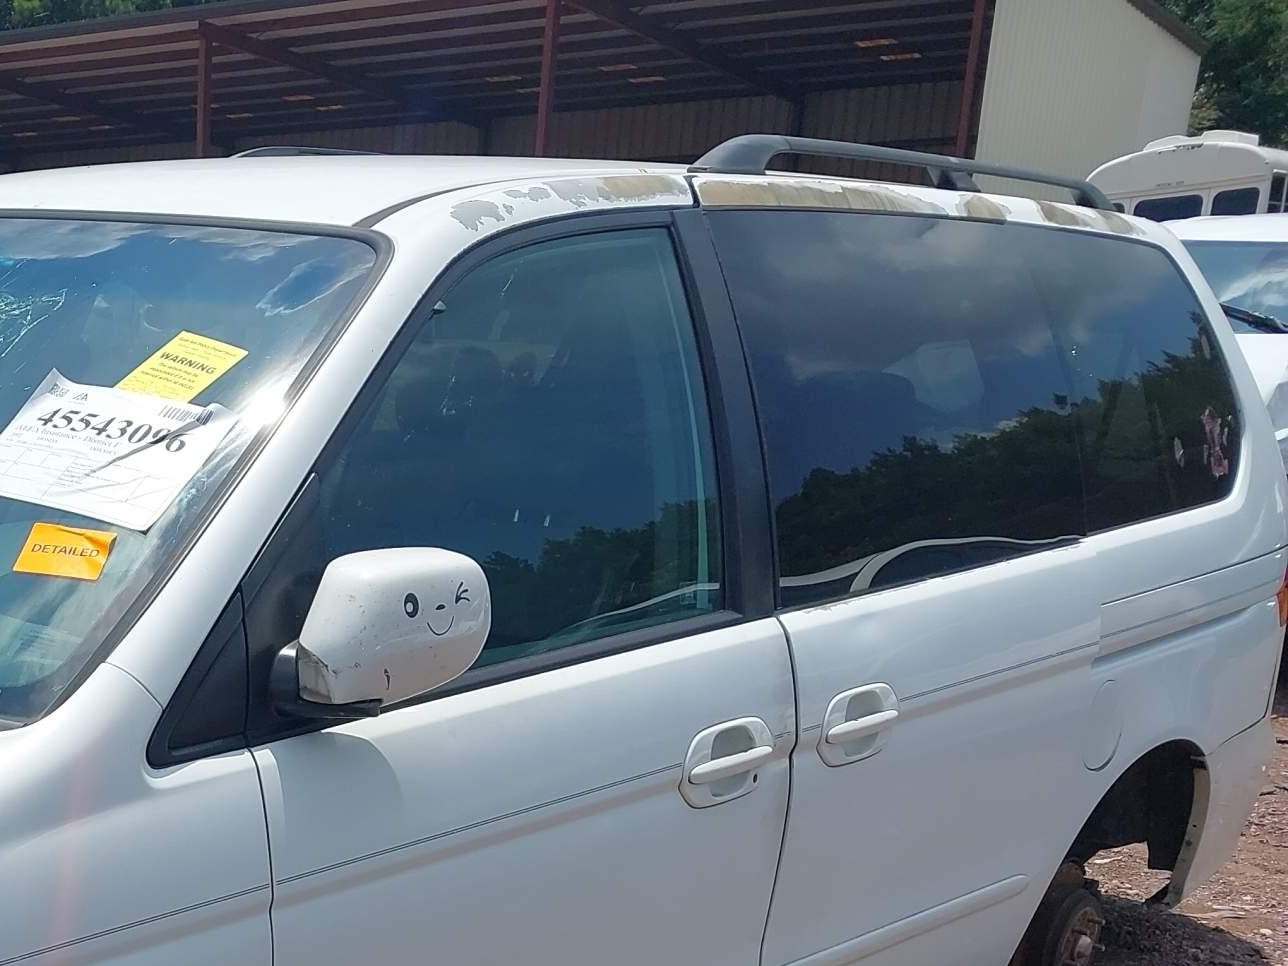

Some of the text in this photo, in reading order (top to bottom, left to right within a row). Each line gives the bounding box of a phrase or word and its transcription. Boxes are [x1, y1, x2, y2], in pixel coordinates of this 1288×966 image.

[160, 351, 216, 375] WARNING
[37, 408, 193, 452] 45543096
[31, 543, 100, 558] DETAILED
